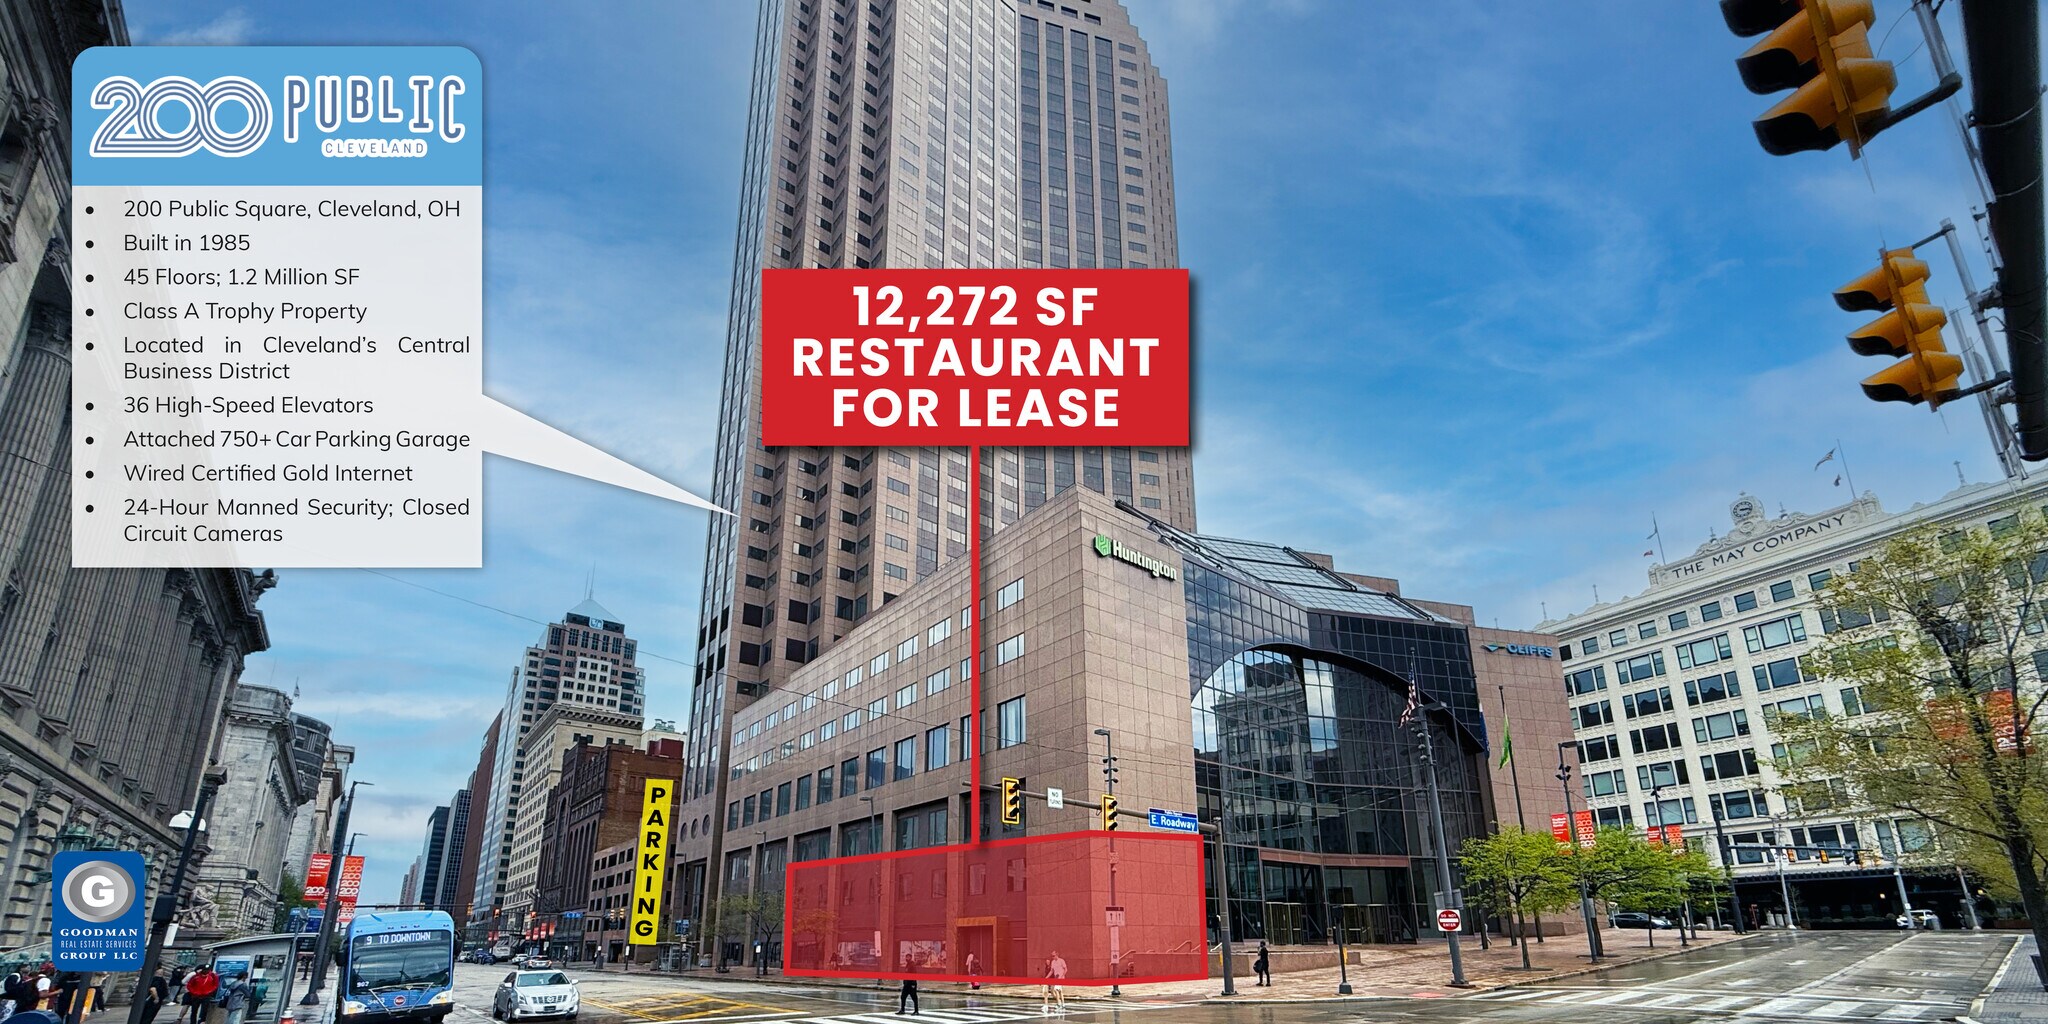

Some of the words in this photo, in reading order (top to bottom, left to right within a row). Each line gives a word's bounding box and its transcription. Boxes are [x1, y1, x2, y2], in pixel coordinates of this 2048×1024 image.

[1672, 560, 1705, 579] THE
[1712, 547, 1746, 566] MAY
[1752, 514, 1846, 553] COMPANY
[1112, 539, 1177, 580] Huntington
[1506, 643, 1554, 657] CLIFFS
[1151, 814, 1159, 824] E.
[1160, 815, 1196, 832] Roadway
[305, 886, 326, 894] 200
[366, 935, 373, 945] 9
[379, 934, 390, 944] TO
[390, 931, 431, 943] DOWNTOWN
